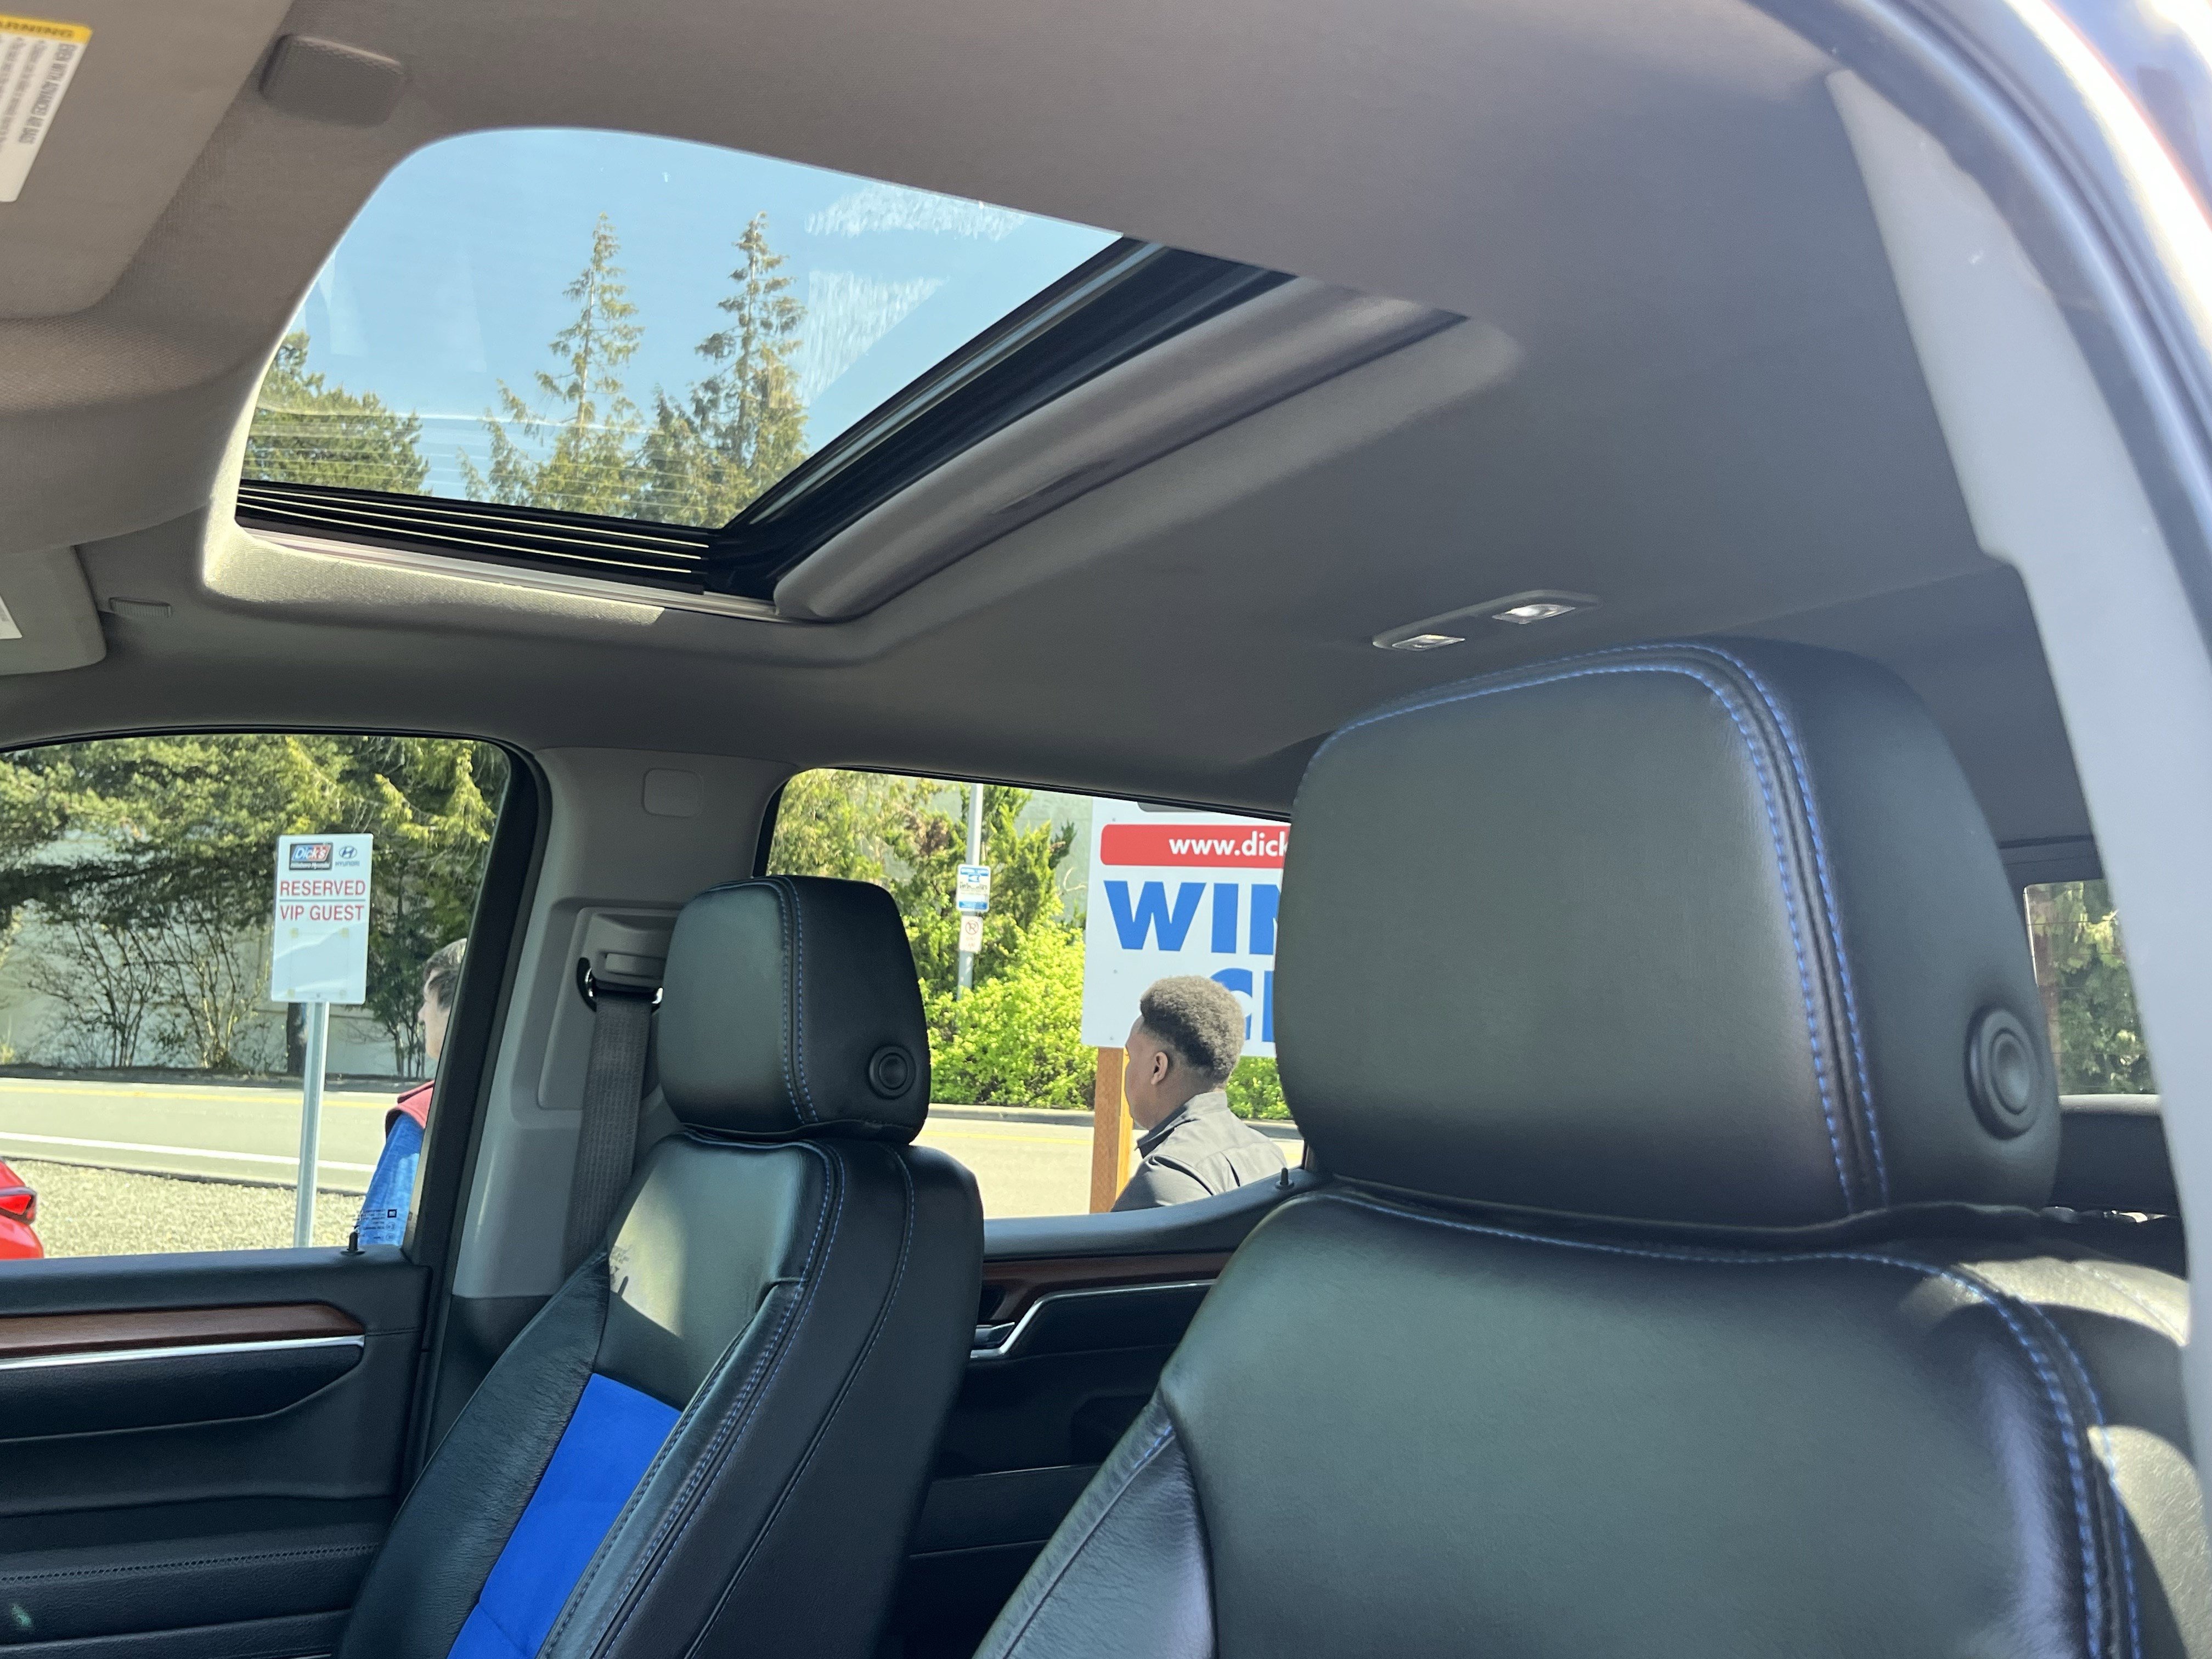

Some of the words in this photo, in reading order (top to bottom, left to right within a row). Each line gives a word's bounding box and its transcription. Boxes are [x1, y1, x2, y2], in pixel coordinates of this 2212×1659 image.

[280, 880, 366, 896] RESERVED
[280, 905, 304, 921] VIP
[309, 905, 365, 921] GUEST
